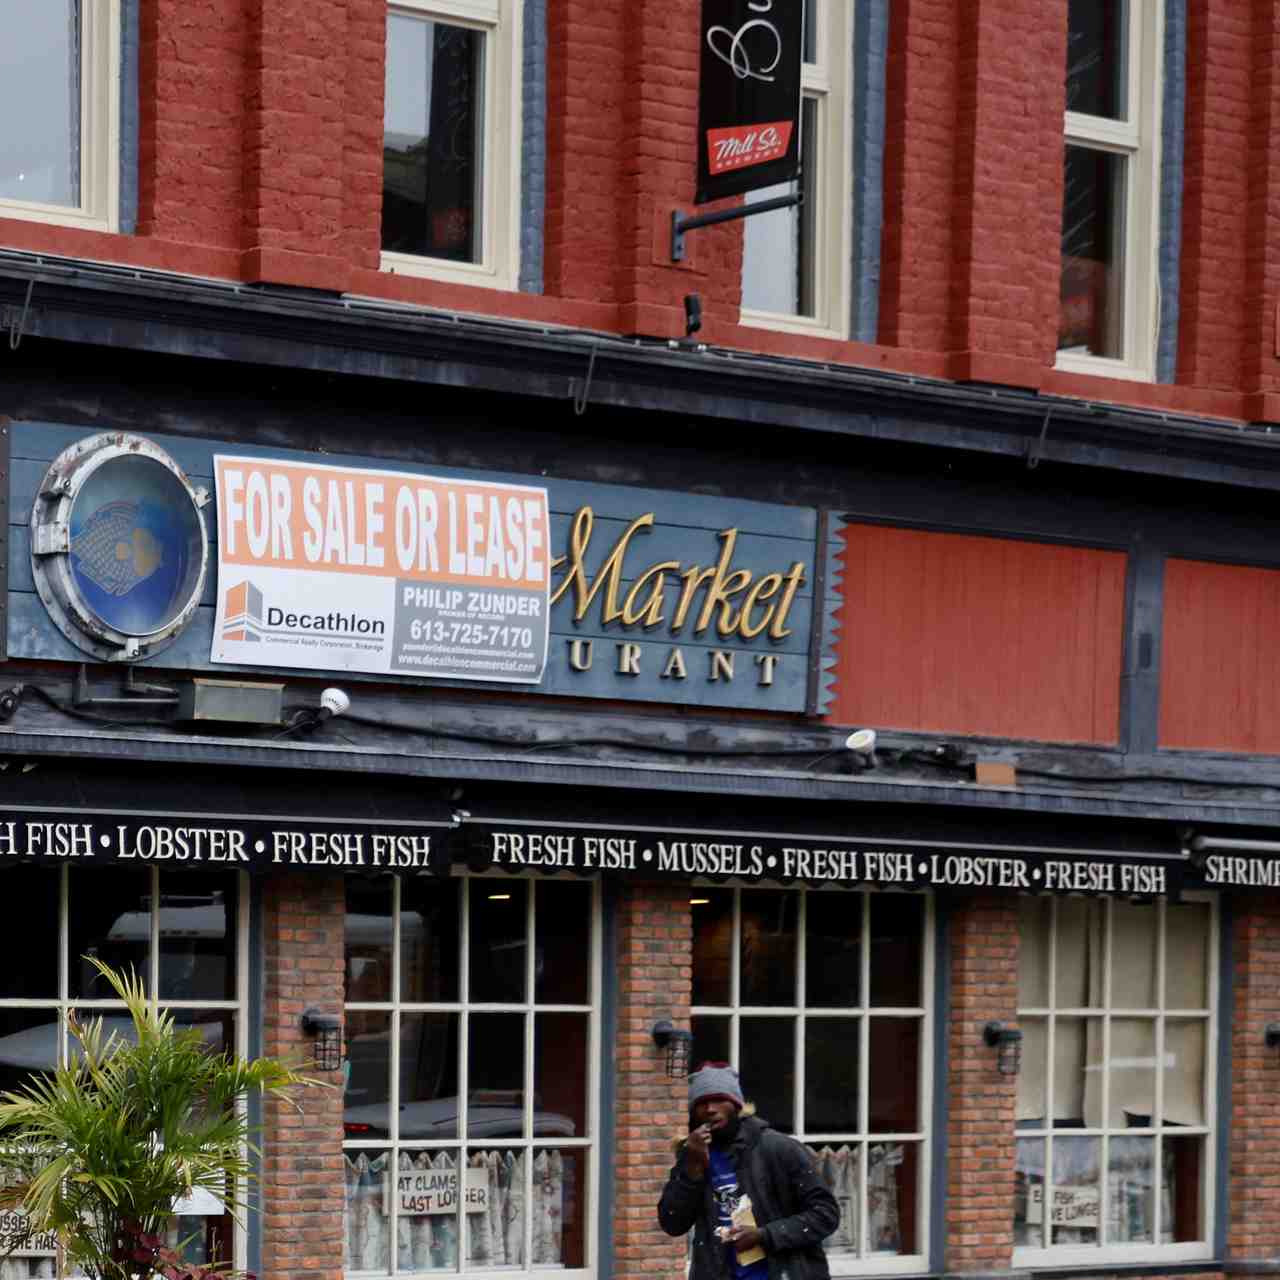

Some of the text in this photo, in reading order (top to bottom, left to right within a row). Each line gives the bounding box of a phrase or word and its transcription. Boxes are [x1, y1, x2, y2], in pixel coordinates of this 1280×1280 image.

[714, 132, 755, 160] Mill
[223, 468, 545, 583] FOR SALE OR LEASE
[550, 506, 807, 640] Market
[403, 586, 541, 617] PHILIP ZUNDER
[267, 607, 385, 635] Decathlon
[410, 619, 532, 649] 613-725-7170
[567, 639, 780, 687] URANT
[25, 822, 96, 858] FISH
[116, 825, 250, 862] LOBSTER
[271, 830, 366, 866] FRESH
[372, 833, 432, 868] FISH
[491, 832, 1167, 893] FRESH FISH MUSSELS FRESH FISH LOBSTER FRESH FISH
[401, 1187, 486, 1213] LAST LONER
